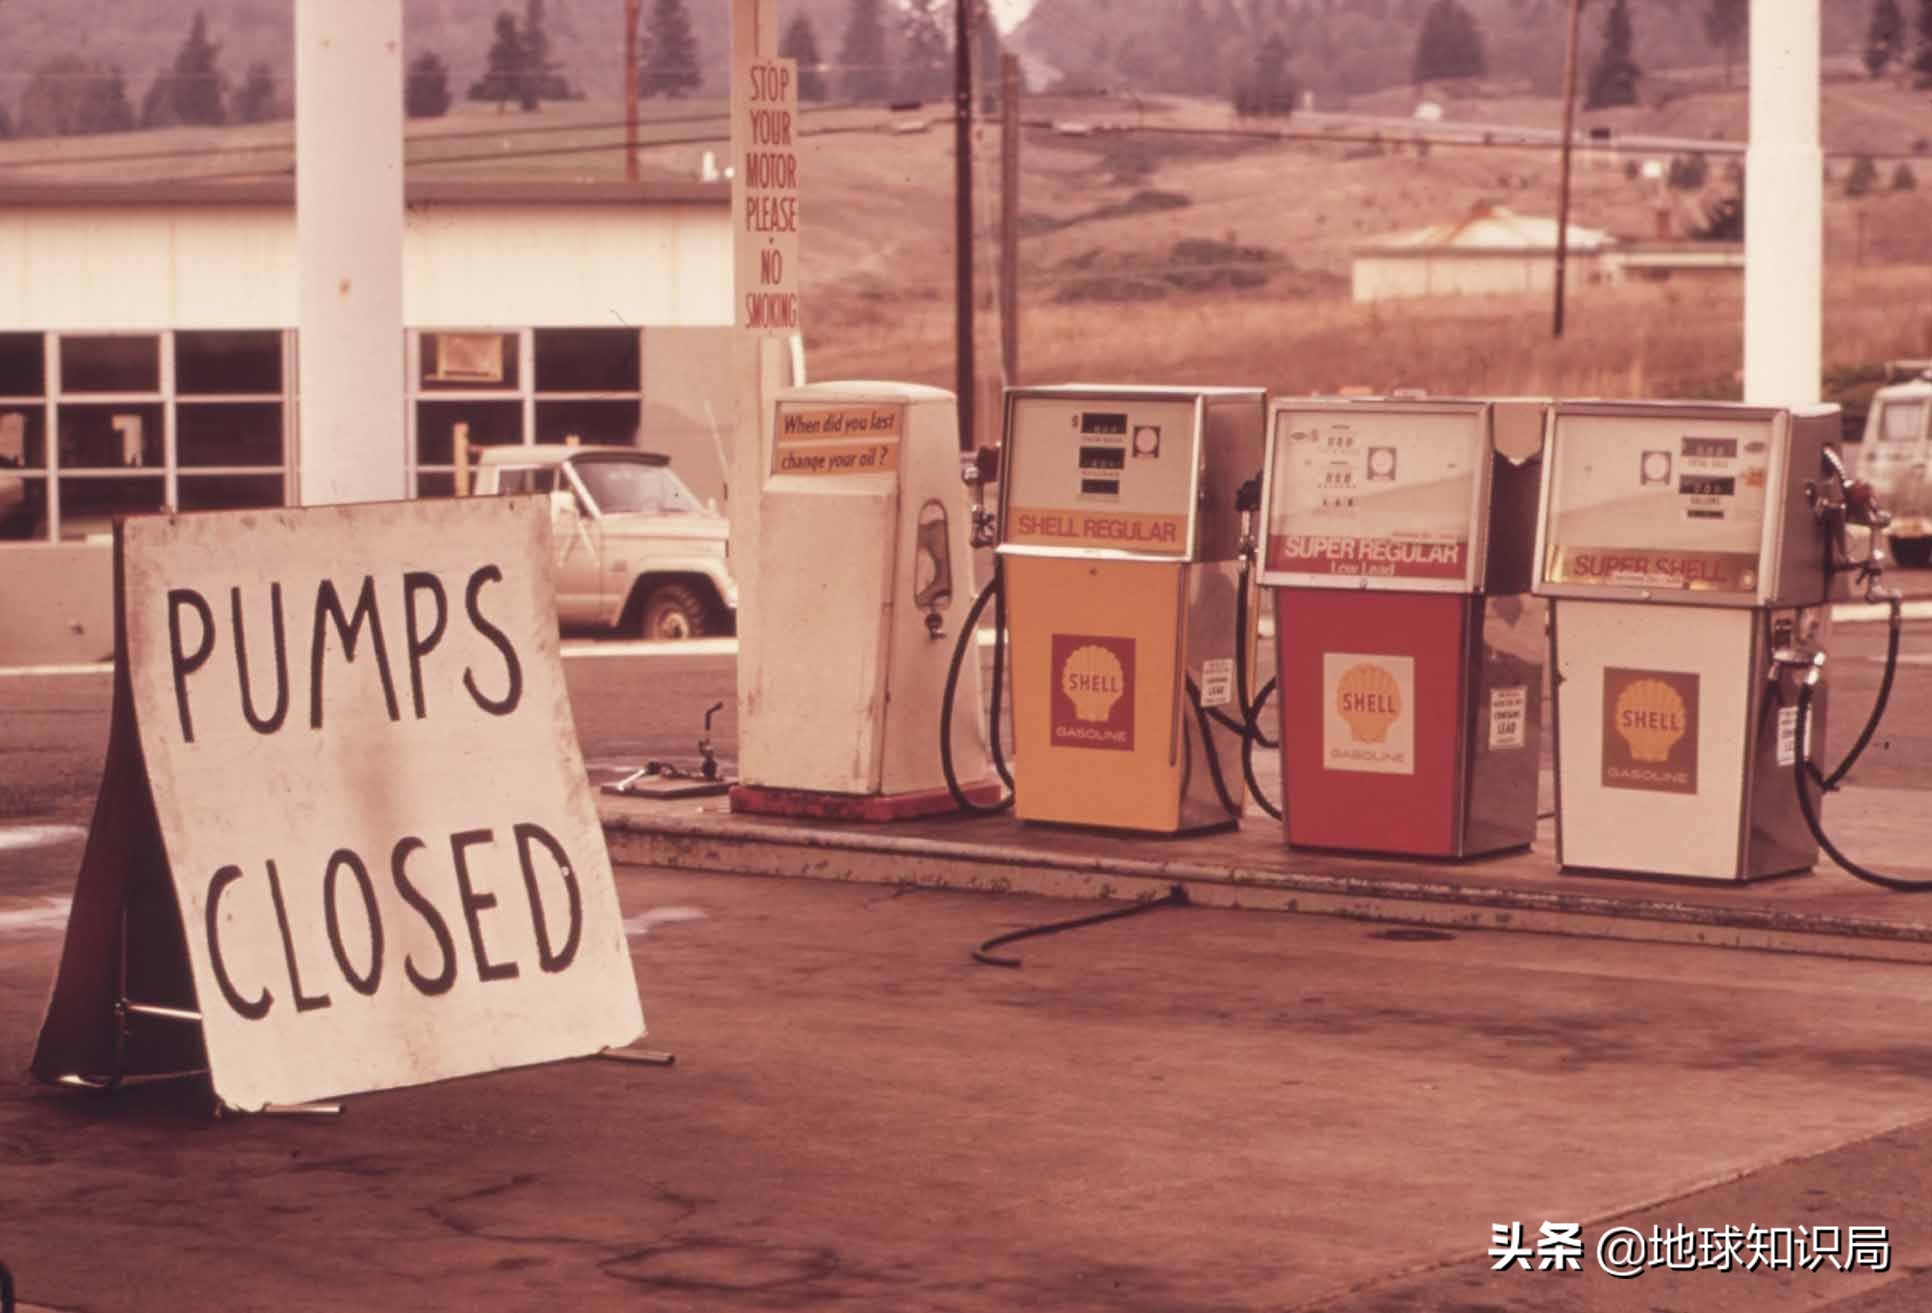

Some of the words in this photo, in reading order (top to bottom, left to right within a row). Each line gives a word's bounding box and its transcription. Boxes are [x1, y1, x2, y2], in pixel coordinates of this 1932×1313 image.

[750, 66, 790, 101] STOP
[750, 110, 792, 145] YOUR
[746, 153, 797, 189] MOTOR
[746, 197, 798, 232] PLEASE
[761, 249, 783, 284] NO
[745, 293, 797, 329] SMOKING
[784, 413, 821, 434] When
[822, 413, 842, 433] did
[844, 419, 868, 434] you
[869, 410, 896, 430] last
[781, 452, 825, 472] change
[828, 454, 857, 473] your
[1018, 514, 1081, 538] SHELL
[1083, 519, 1178, 543] REGULAR
[1284, 536, 1356, 559] SUPER
[1358, 538, 1459, 564] REGULAR
[1574, 553, 1649, 576] SUPER
[1655, 556, 1728, 583] SHELL
[167, 564, 524, 743] PUMPS
[1069, 673, 1120, 693] SHELL
[1343, 693, 1396, 713] SHELL
[1055, 725, 1129, 743] GASOLINE
[1622, 709, 1681, 731] SHELL
[1607, 766, 1689, 784] GASOLINE
[205, 823, 583, 1020] CLOSED
